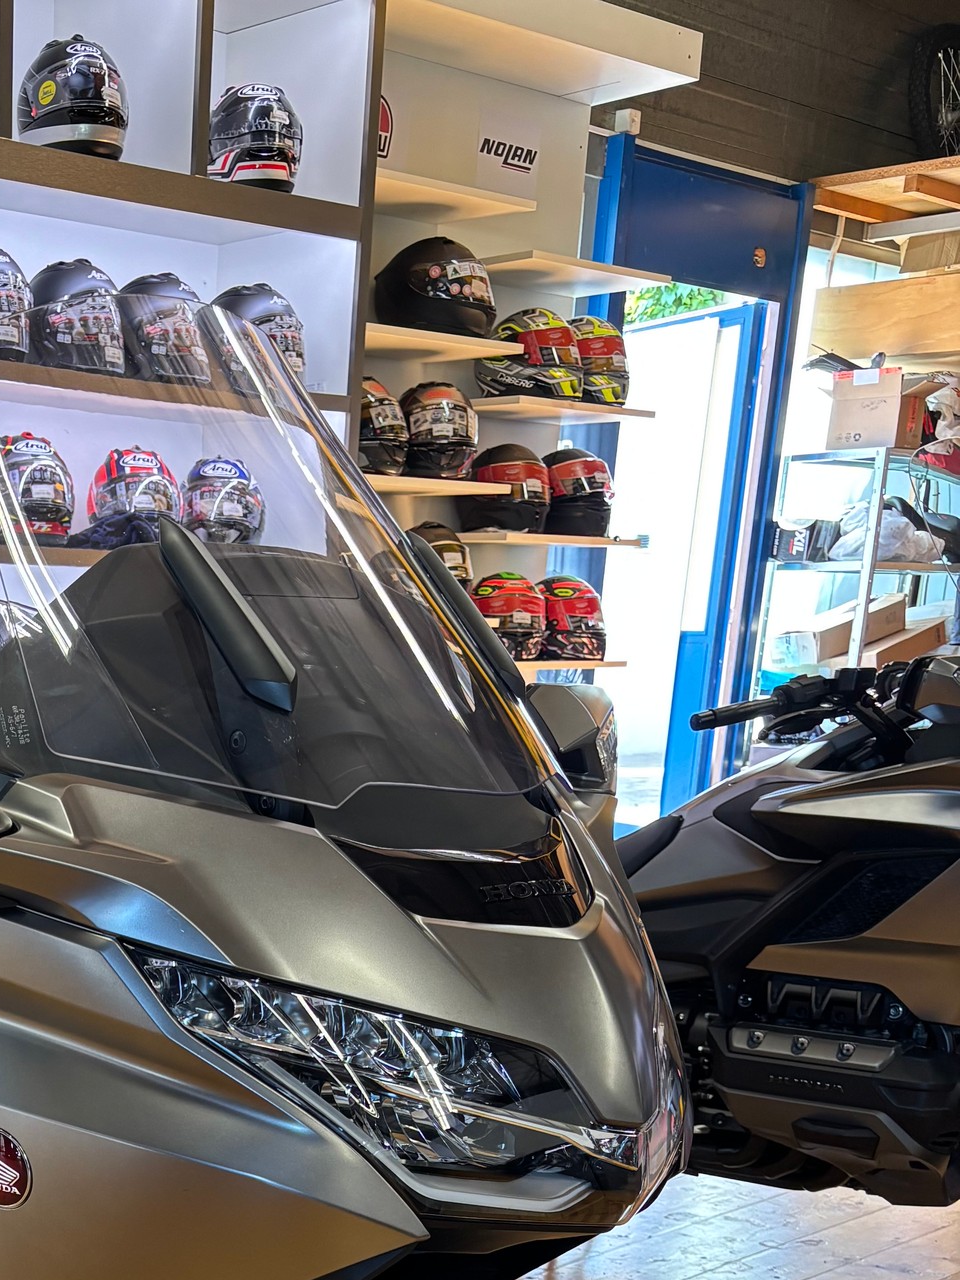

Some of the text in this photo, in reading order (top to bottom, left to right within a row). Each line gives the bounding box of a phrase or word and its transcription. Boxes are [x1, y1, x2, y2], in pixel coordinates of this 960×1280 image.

[71, 44, 99, 54] Arai
[248, 85, 274, 95] Arai
[479, 138, 538, 171] NOLAN
[496, 372, 537, 388] CABERG
[22, 441, 48, 452] Arai
[128, 454, 154, 464] Arai
[208, 464, 234, 475] Arai
